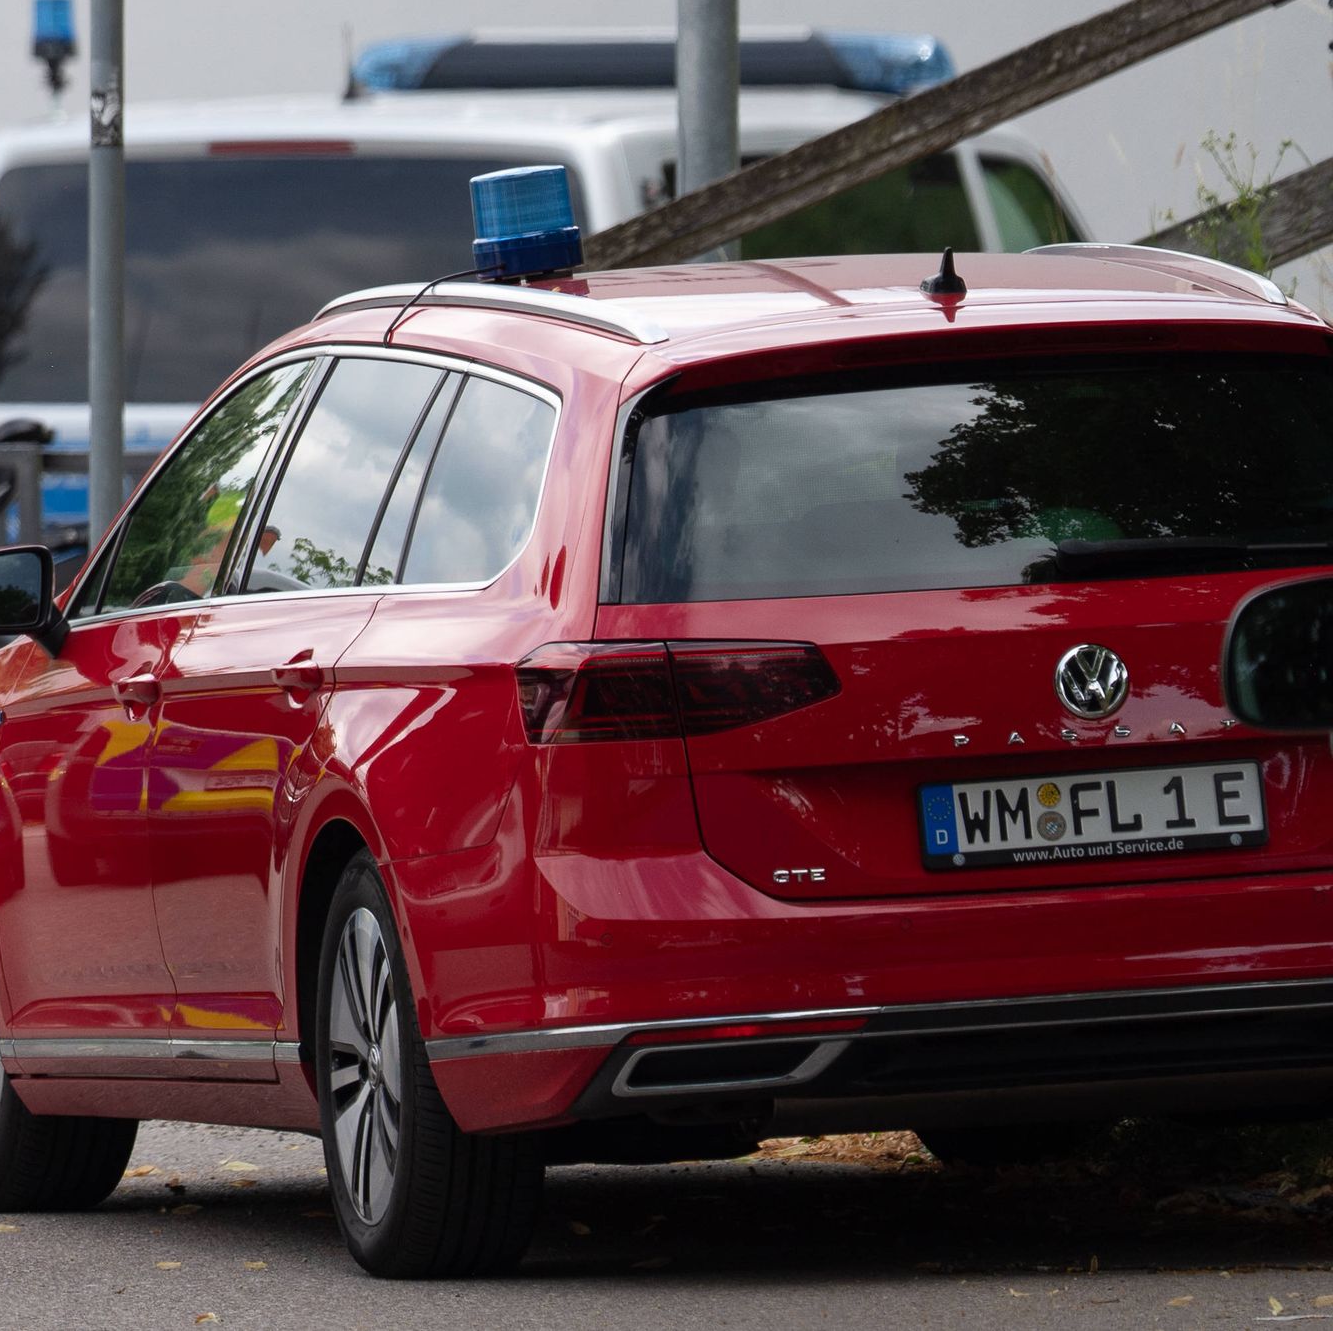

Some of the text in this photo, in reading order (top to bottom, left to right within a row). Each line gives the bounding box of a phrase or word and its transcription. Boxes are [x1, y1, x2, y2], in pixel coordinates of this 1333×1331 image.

[953, 716, 1236, 748] PASSAT
[958, 786, 1033, 845] WM
[1069, 780, 1144, 837] FL
[1013, 837, 1185, 864] www.Auto und Service.de
[773, 867, 826, 883] GTE
